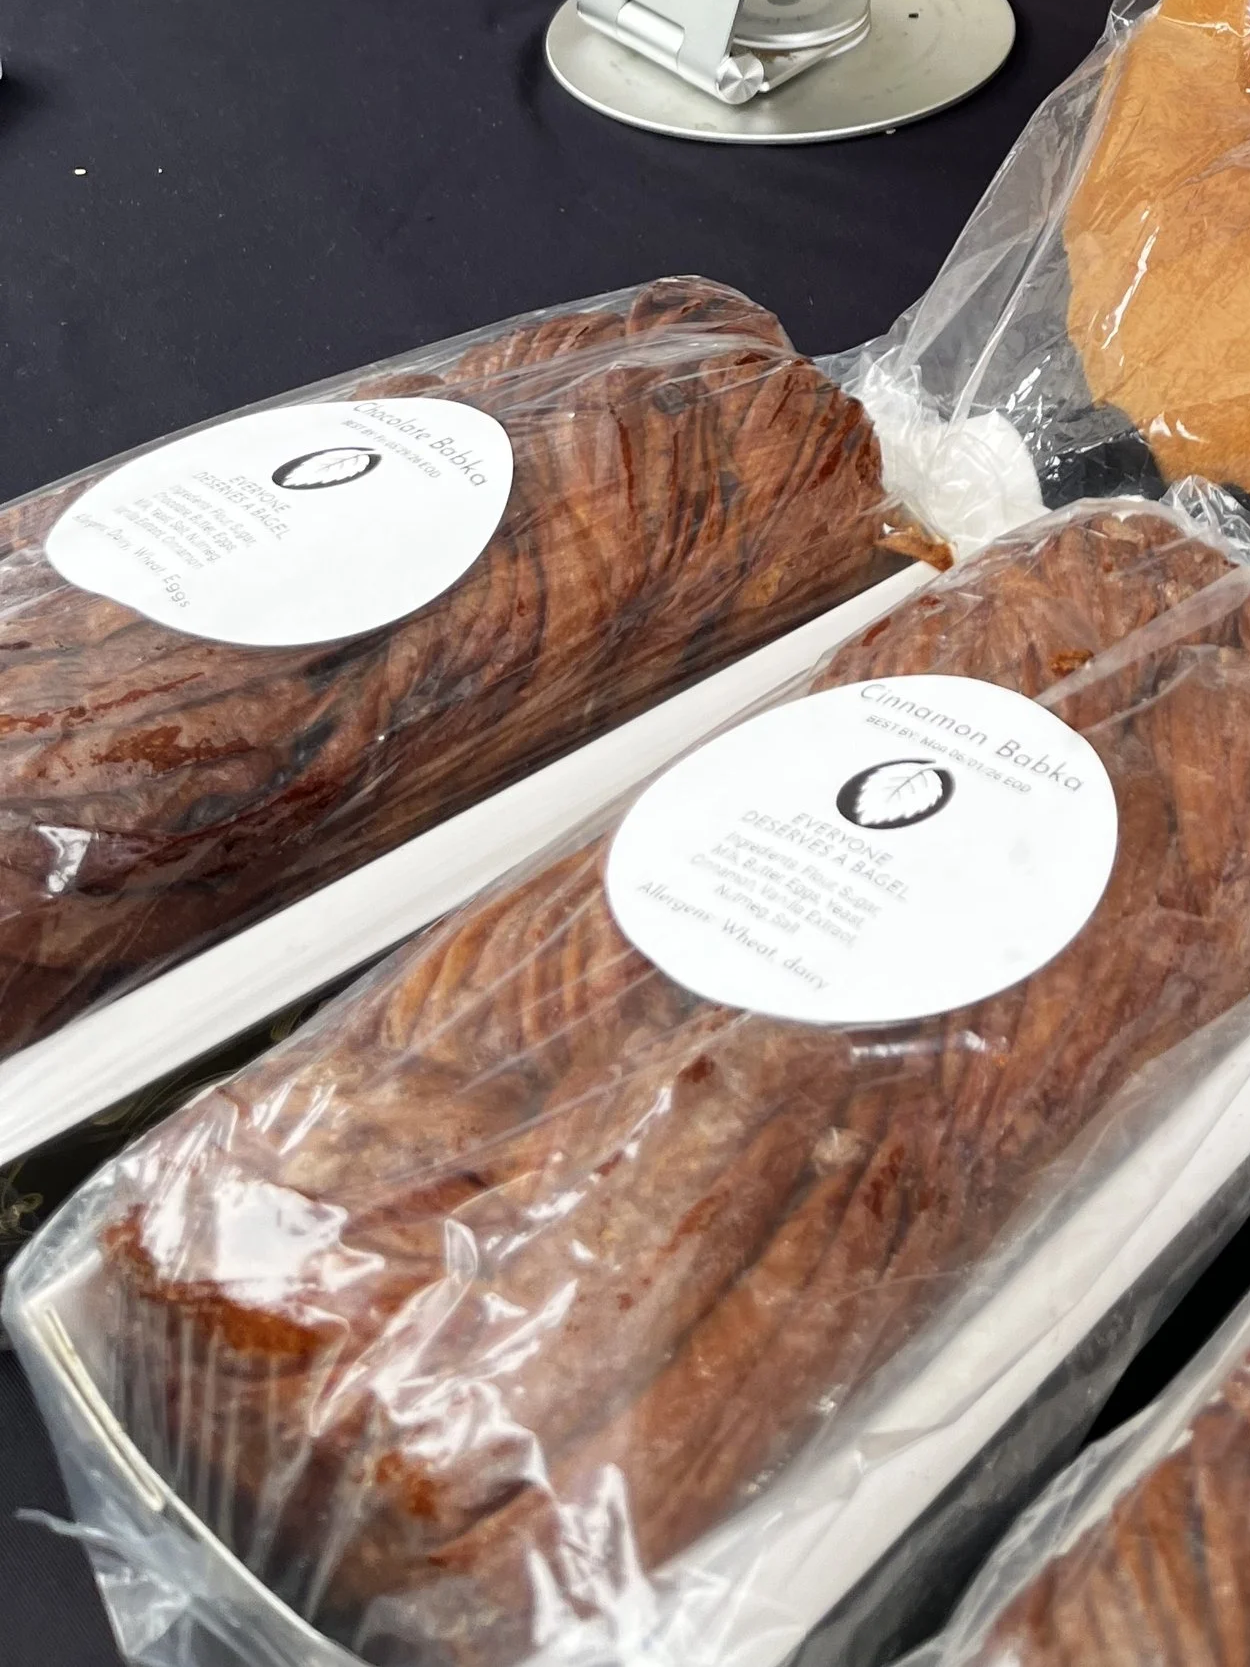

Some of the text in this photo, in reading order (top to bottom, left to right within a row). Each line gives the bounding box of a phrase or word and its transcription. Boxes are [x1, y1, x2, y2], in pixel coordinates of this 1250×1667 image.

[353, 402, 488, 487] Chocolate Babka
[418, 461, 443, 479] EOD
[191, 470, 249, 507] DESERVES
[250, 504, 291, 542] BAGEL
[228, 474, 293, 514] EVERYONE
[162, 573, 191, 609] Eggs
[860, 683, 1084, 793] Cinnamon Babka
[865, 714, 899, 732] BEST
[1002, 775, 1033, 795] EOD
[739, 808, 835, 860] DESERVES
[848, 859, 911, 904] BAGEL
[791, 811, 894, 870] EVERYONE
[782, 954, 829, 991] dairy
